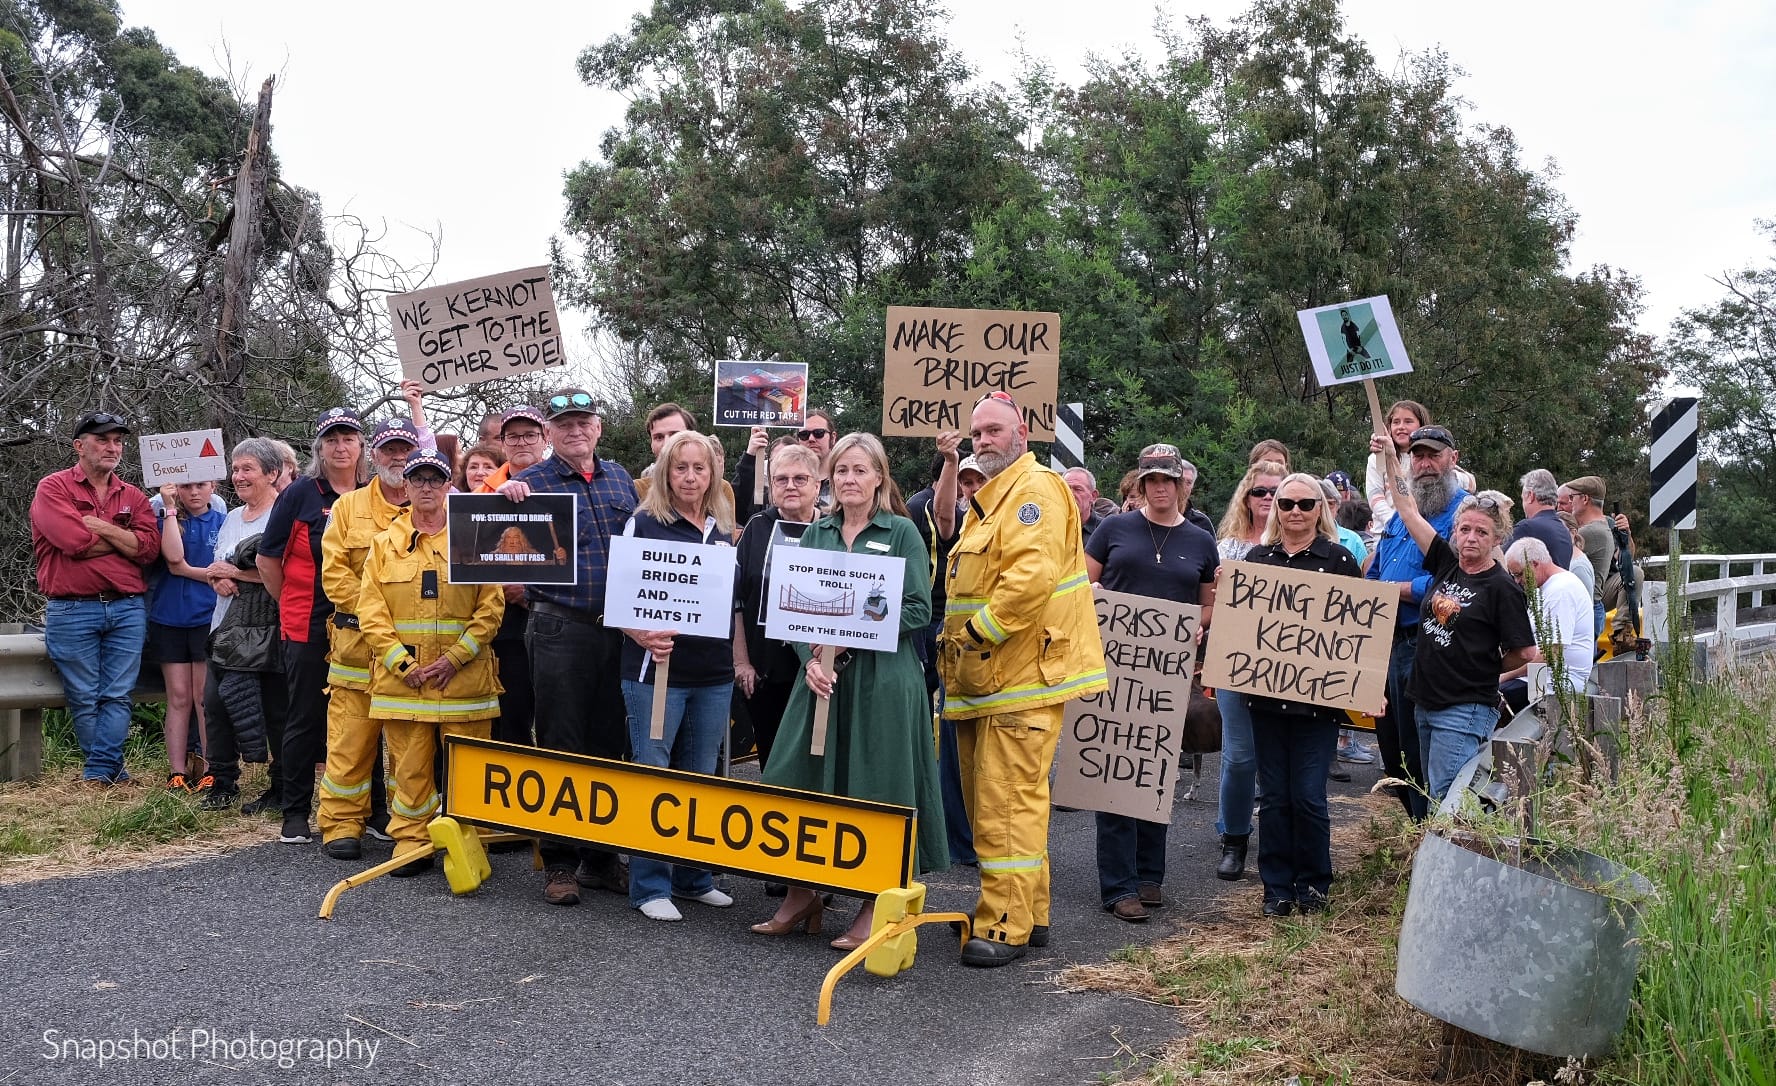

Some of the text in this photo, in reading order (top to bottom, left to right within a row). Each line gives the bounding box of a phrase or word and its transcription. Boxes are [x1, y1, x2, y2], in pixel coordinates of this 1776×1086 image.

[396, 276, 546, 331] WE KERNOT
[418, 310, 552, 357] GET TO THE
[892, 318, 1050, 356] MAKE OUR
[422, 335, 565, 385] OTHER SIDE!
[914, 356, 1038, 391] BRIDGE
[1340, 358, 1385, 376] JUST DO IT!
[723, 409, 799, 421] CUT THE RED TAPE
[888, 396, 962, 430] GREAT
[170, 437, 191, 449] OUR
[471, 513, 487, 522] POV:
[487, 513, 519, 522] STEWART
[528, 513, 553, 522] BRIDGE
[480, 553, 546, 562] YOU SHALL NOT PASS
[641, 550, 702, 566] BUILD A
[788, 564, 886, 581] STOP BEING SUCH A
[641, 569, 699, 585] BRIDGE
[818, 579, 853, 590] TROLL!
[637, 588, 669, 601] AND
[1225, 568, 1390, 629] BRING BACK
[633, 607, 702, 624] THATS IT
[788, 624, 879, 640] OPEN THE BRIDGE!
[1174, 613, 1195, 643] IS
[1256, 616, 1373, 665] KERNOT
[1100, 639, 1191, 680] REENER
[1225, 650, 1362, 703] BRIDGE!
[1123, 676, 1175, 715] THE
[1073, 713, 1174, 759] OTHER
[1079, 746, 1169, 797] SIDE!
[483, 762, 868, 871] ROAD CLOSED
